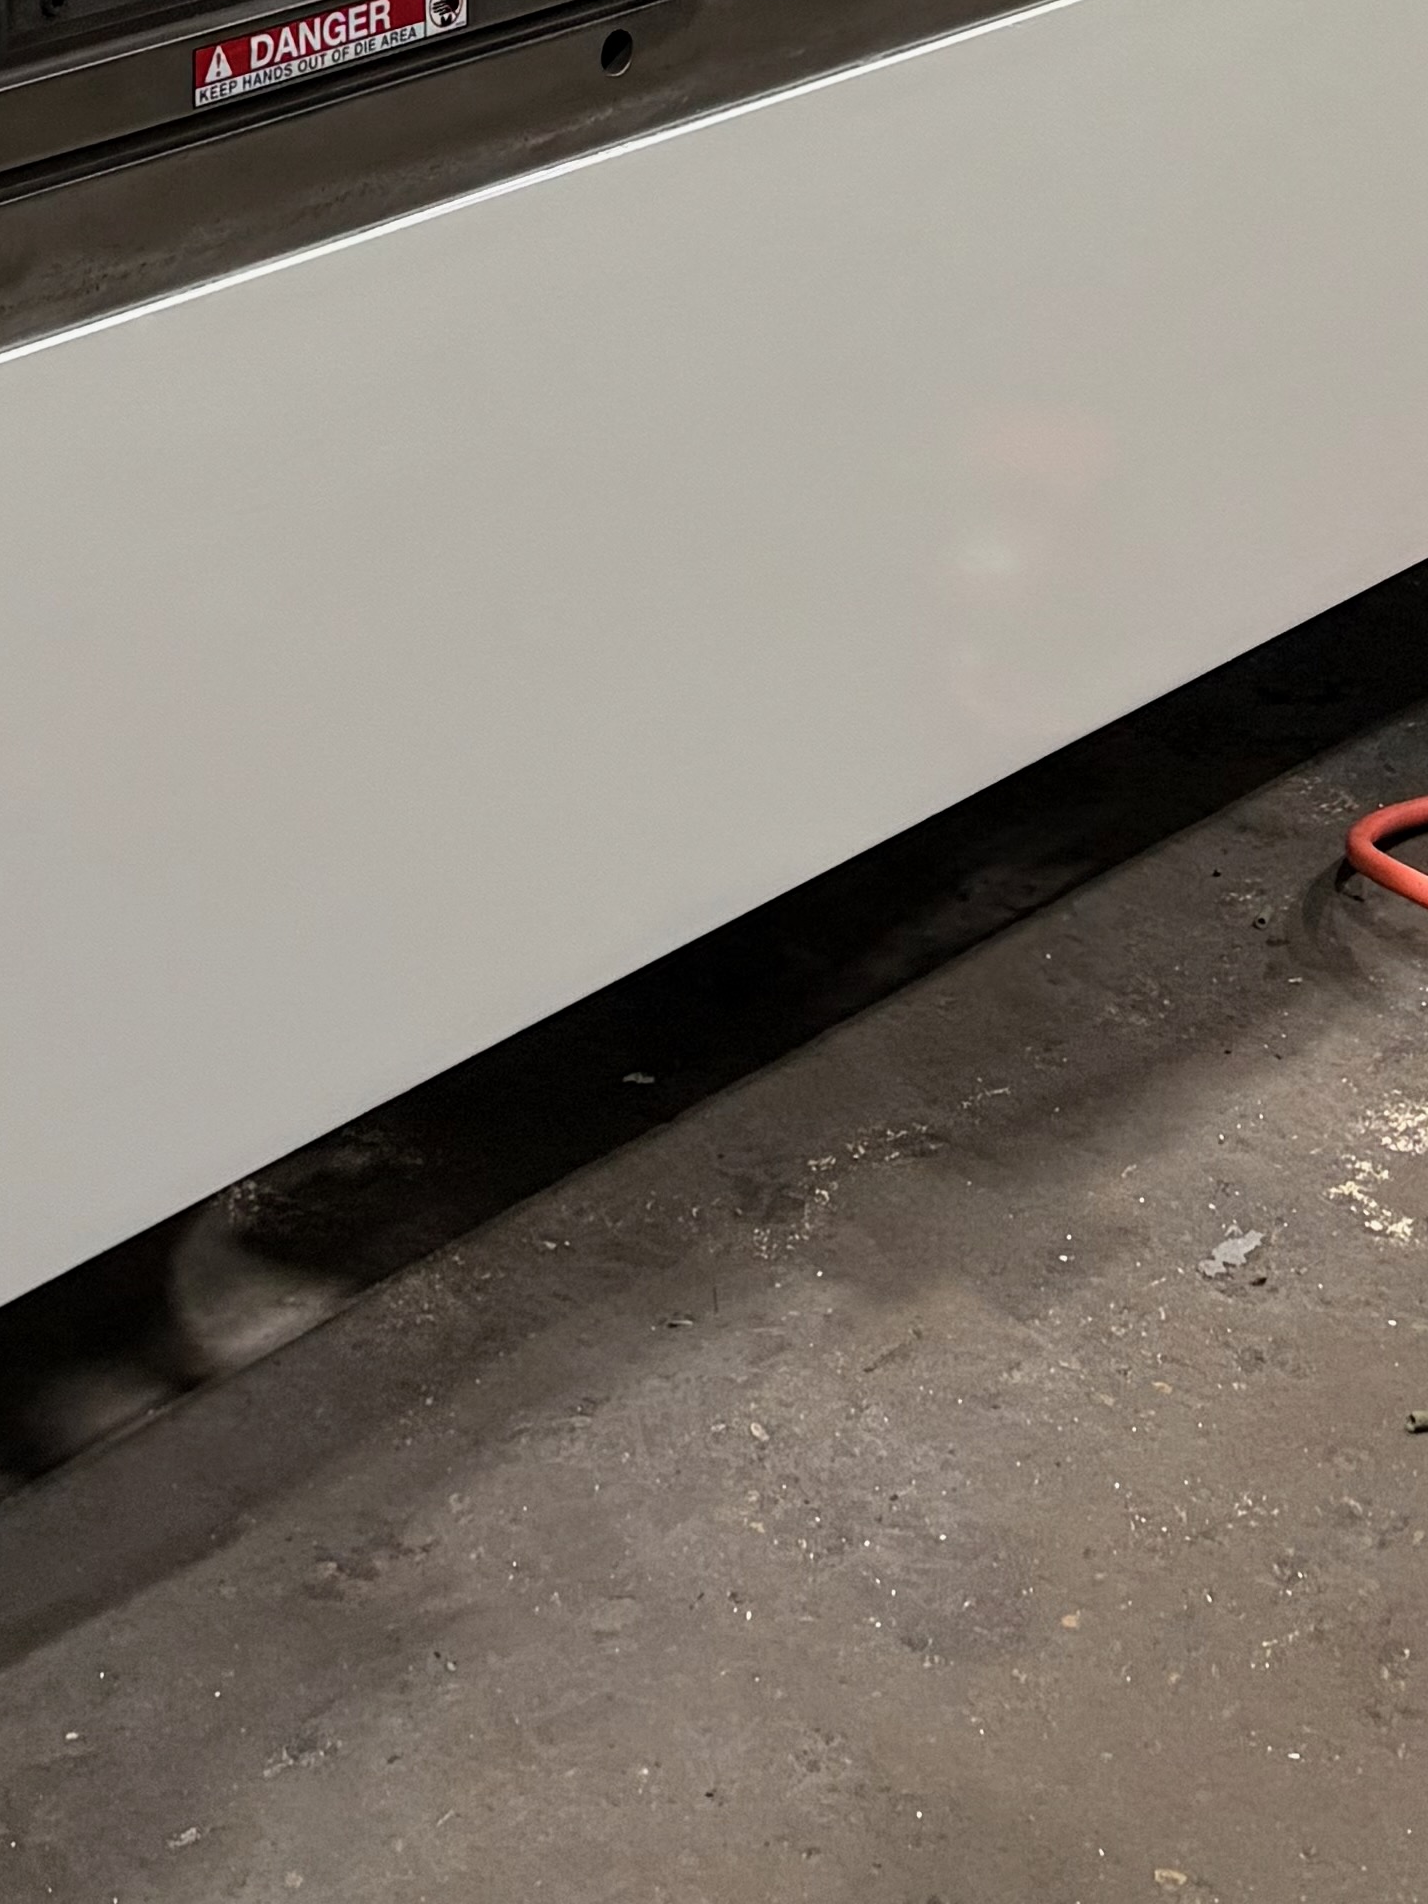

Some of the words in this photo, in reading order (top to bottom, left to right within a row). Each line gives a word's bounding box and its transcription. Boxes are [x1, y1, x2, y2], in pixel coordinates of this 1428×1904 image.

[199, 80, 238, 104] KEEP
[242, 63, 293, 89] HANDS
[297, 54, 326, 73] OUT
[331, 48, 350, 64] OF
[354, 41, 376, 57] DIE
[380, 27, 417, 49] AREA
